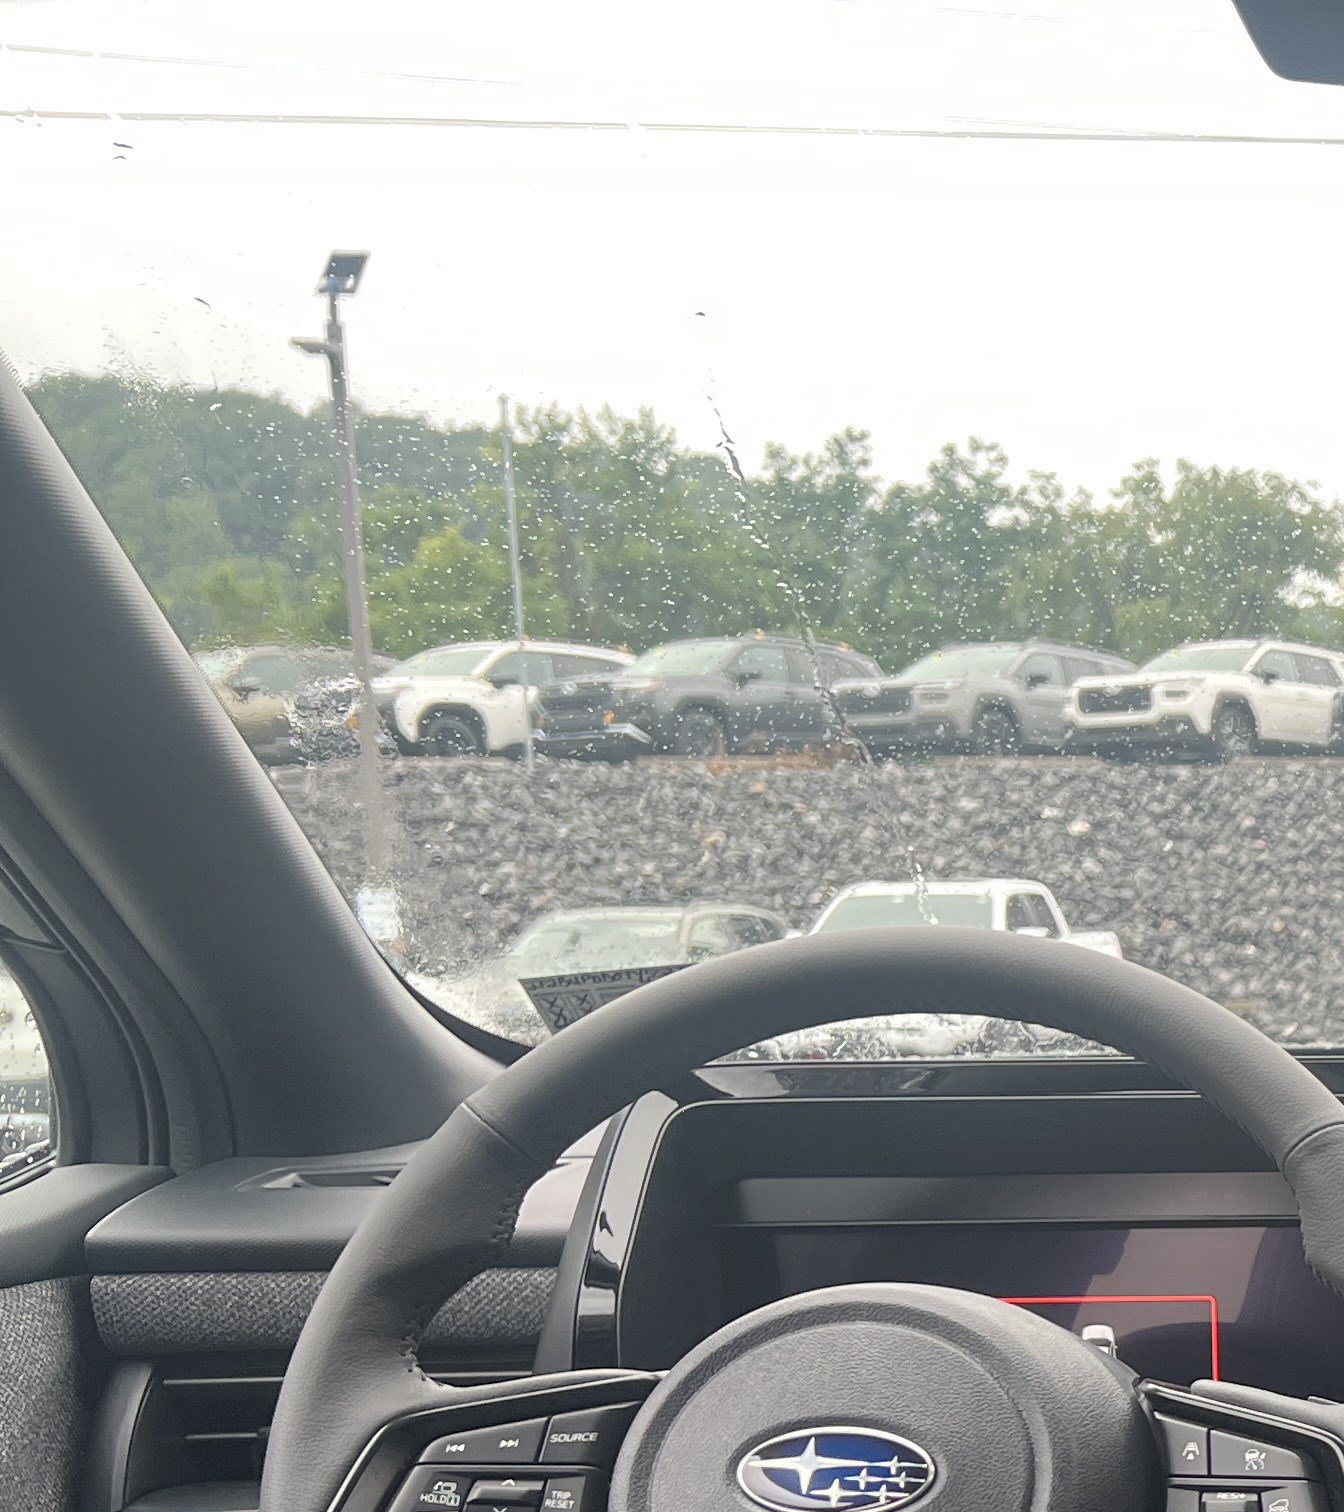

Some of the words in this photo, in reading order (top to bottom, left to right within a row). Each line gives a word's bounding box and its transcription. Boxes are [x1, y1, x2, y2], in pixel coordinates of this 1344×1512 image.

[550, 1431, 598, 1444] SOURCE
[420, 1493, 447, 1504] HOLD
[551, 1490, 572, 1500] TRIP
[545, 1498, 575, 1510] RESET
